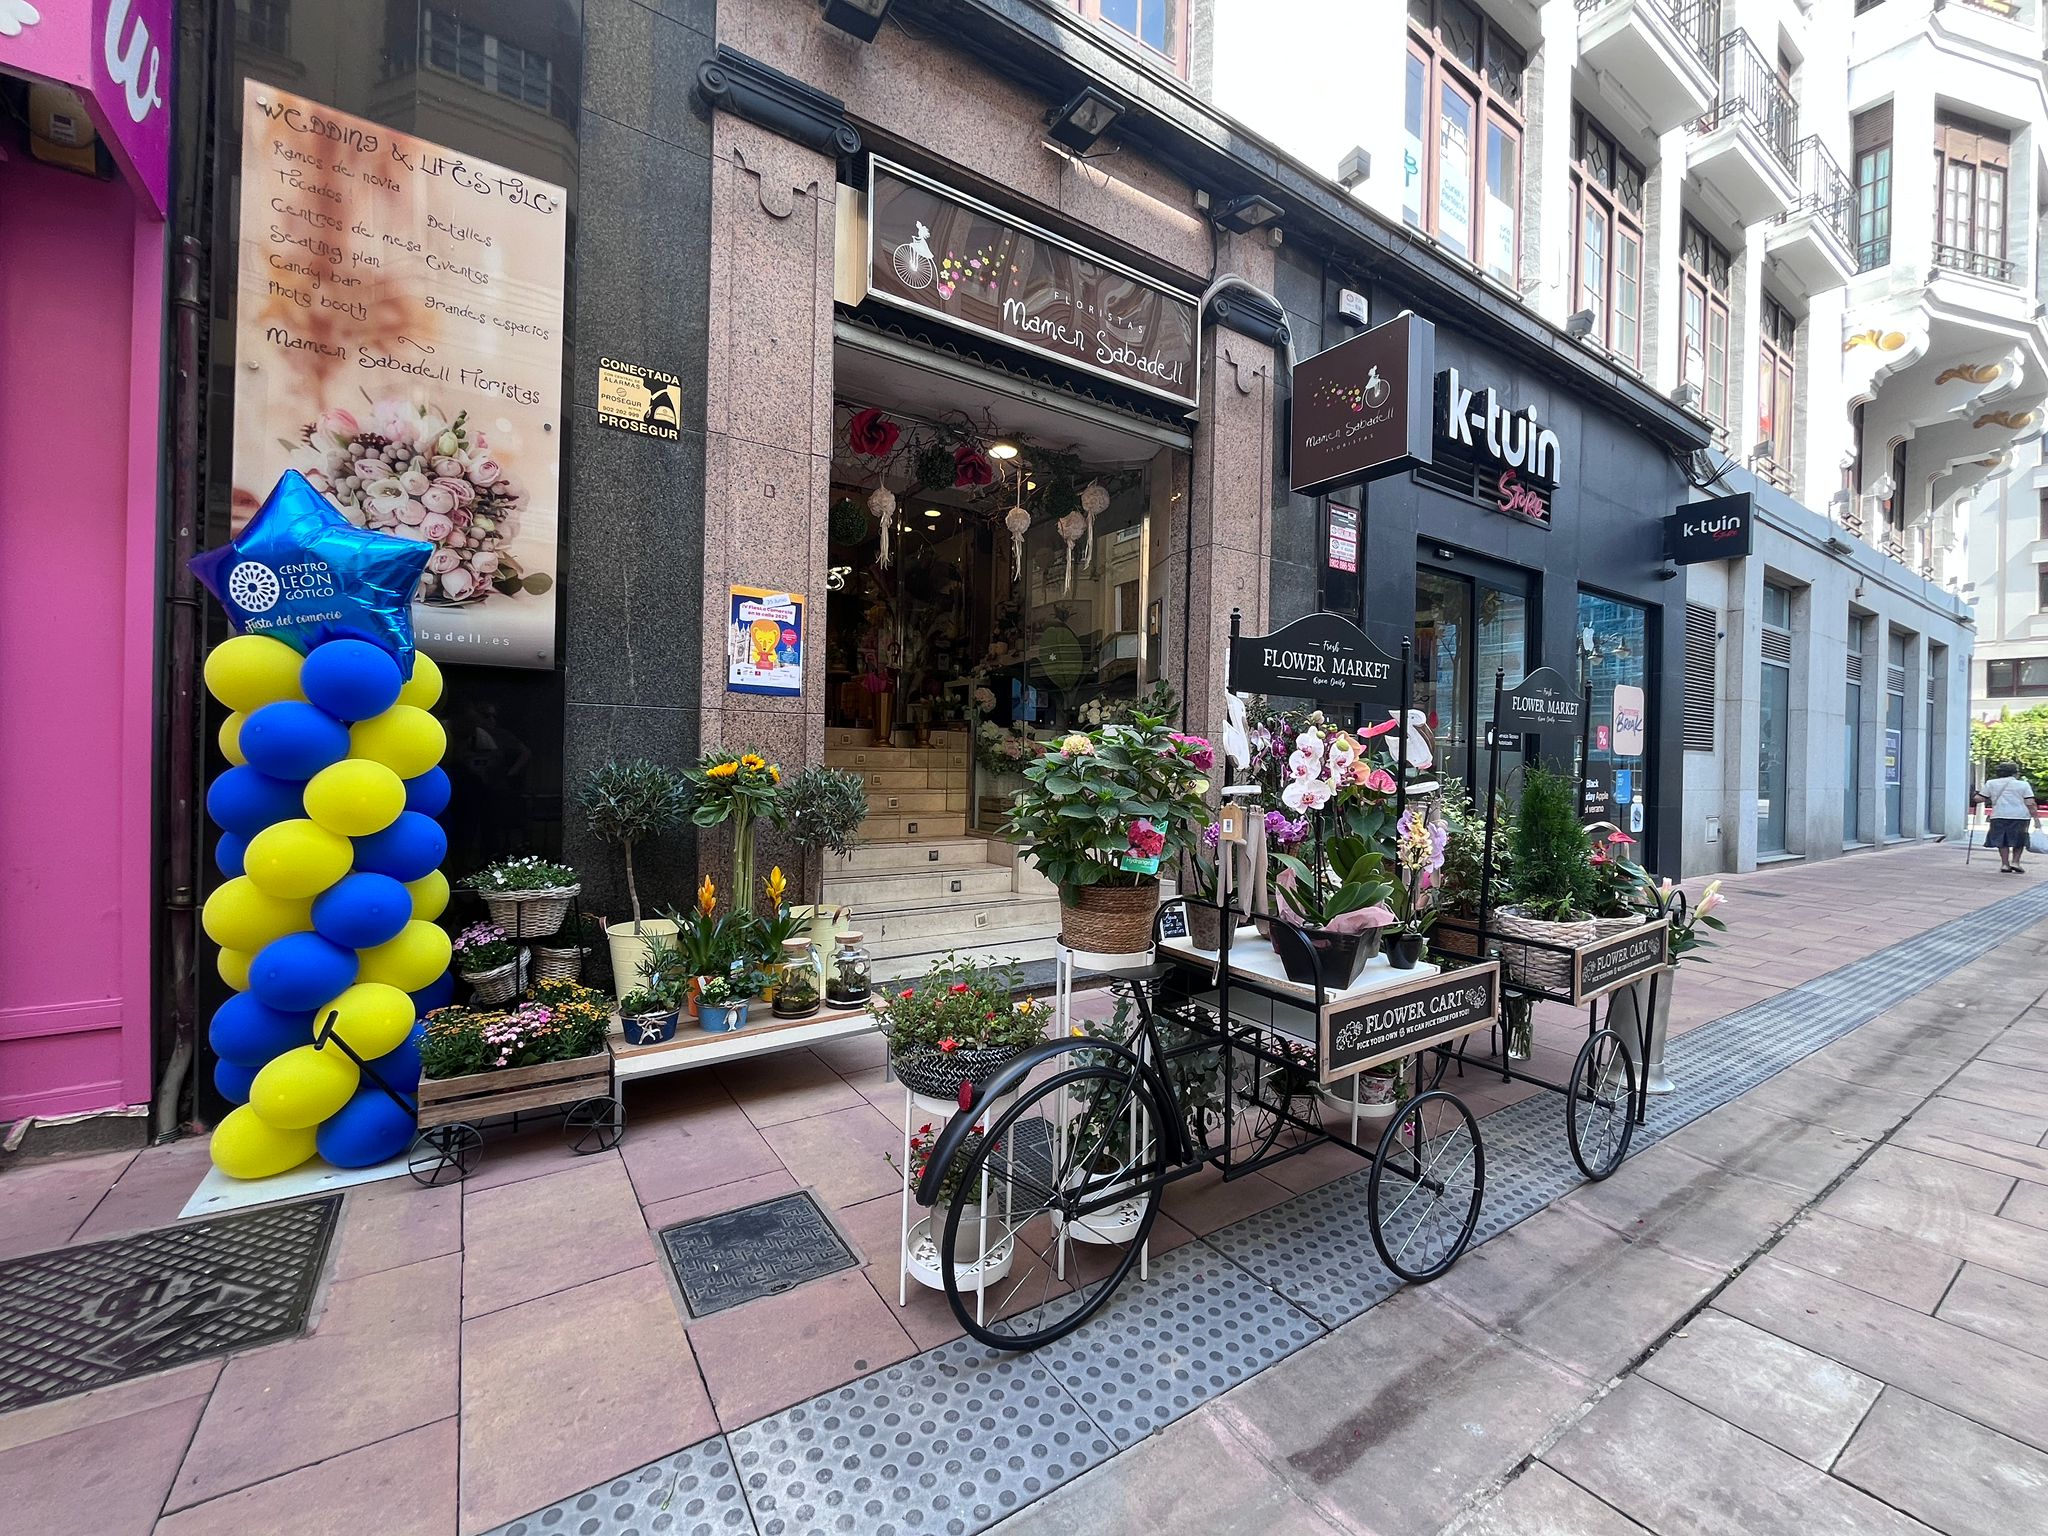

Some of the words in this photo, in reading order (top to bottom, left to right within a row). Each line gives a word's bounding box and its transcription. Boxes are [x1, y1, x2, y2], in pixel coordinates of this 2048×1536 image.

[273, 140, 323, 170] Ramos
[332, 161, 354, 178] de
[363, 172, 401, 193] novia
[273, 168, 342, 203] Tocados
[271, 198, 343, 232] Centros
[352, 221, 374, 238] de
[383, 234, 421, 252] mesa
[427, 214, 492, 247] Detalles
[270, 225, 343, 264] Seating
[352, 251, 381, 268] plan
[269, 254, 321, 289] Candy
[330, 272, 362, 287] bar
[425, 254, 489, 284] Eventos
[321, 295, 368, 321] booth
[1054, 292, 1143, 334] FLORISTAS
[493, 317, 550, 341] espacios
[1003, 297, 1085, 352] Mamen
[1096, 330, 1183, 385] Sabadell
[266, 327, 347, 360] Mamen
[358, 346, 450, 382] Sabadell
[460, 368, 541, 405] Floristas
[600, 357, 680, 386] CONECTADA
[603, 376, 641, 390] ALARMAS
[601, 393, 642, 408] PROSEGUR
[599, 413, 678, 441] PROSEGUR
[1305, 429, 1341, 448] Mamen
[1345, 407, 1394, 437] Sabadell
[1449, 367, 1561, 484] k-tuin
[1683, 515, 1741, 537] k-tuin
[279, 562, 328, 575] CENTRO
[281, 572, 332, 590] LEÓN
[285, 587, 334, 600] GÓTICO
[1323, 640, 1340, 652] Fresh
[1263, 648, 1326, 673] FLOWER
[1332, 657, 1390, 680] MARKET
[1312, 676, 1328, 685] Open
[1330, 677, 1346, 688] Daily
[1512, 696, 1545, 713] FLOWER
[1547, 700, 1579, 716] MARKET
[1585, 791, 1595, 802] iday
[1597, 947, 1629, 971] FLOWER
[1629, 940, 1648, 957] CART
[1365, 1001, 1427, 1034] FLOWER
[1429, 989, 1464, 1014] CART
[1356, 1040, 1370, 1050] PICK
[1370, 1035, 1385, 1046] YOUR
[1386, 1031, 1398, 1041] OWN
[1399, 1027, 1405, 1038] &
[1406, 1026, 1415, 1034] WE
[1415, 1022, 1425, 1032] CAN
[1425, 1018, 1437, 1028] PICK
